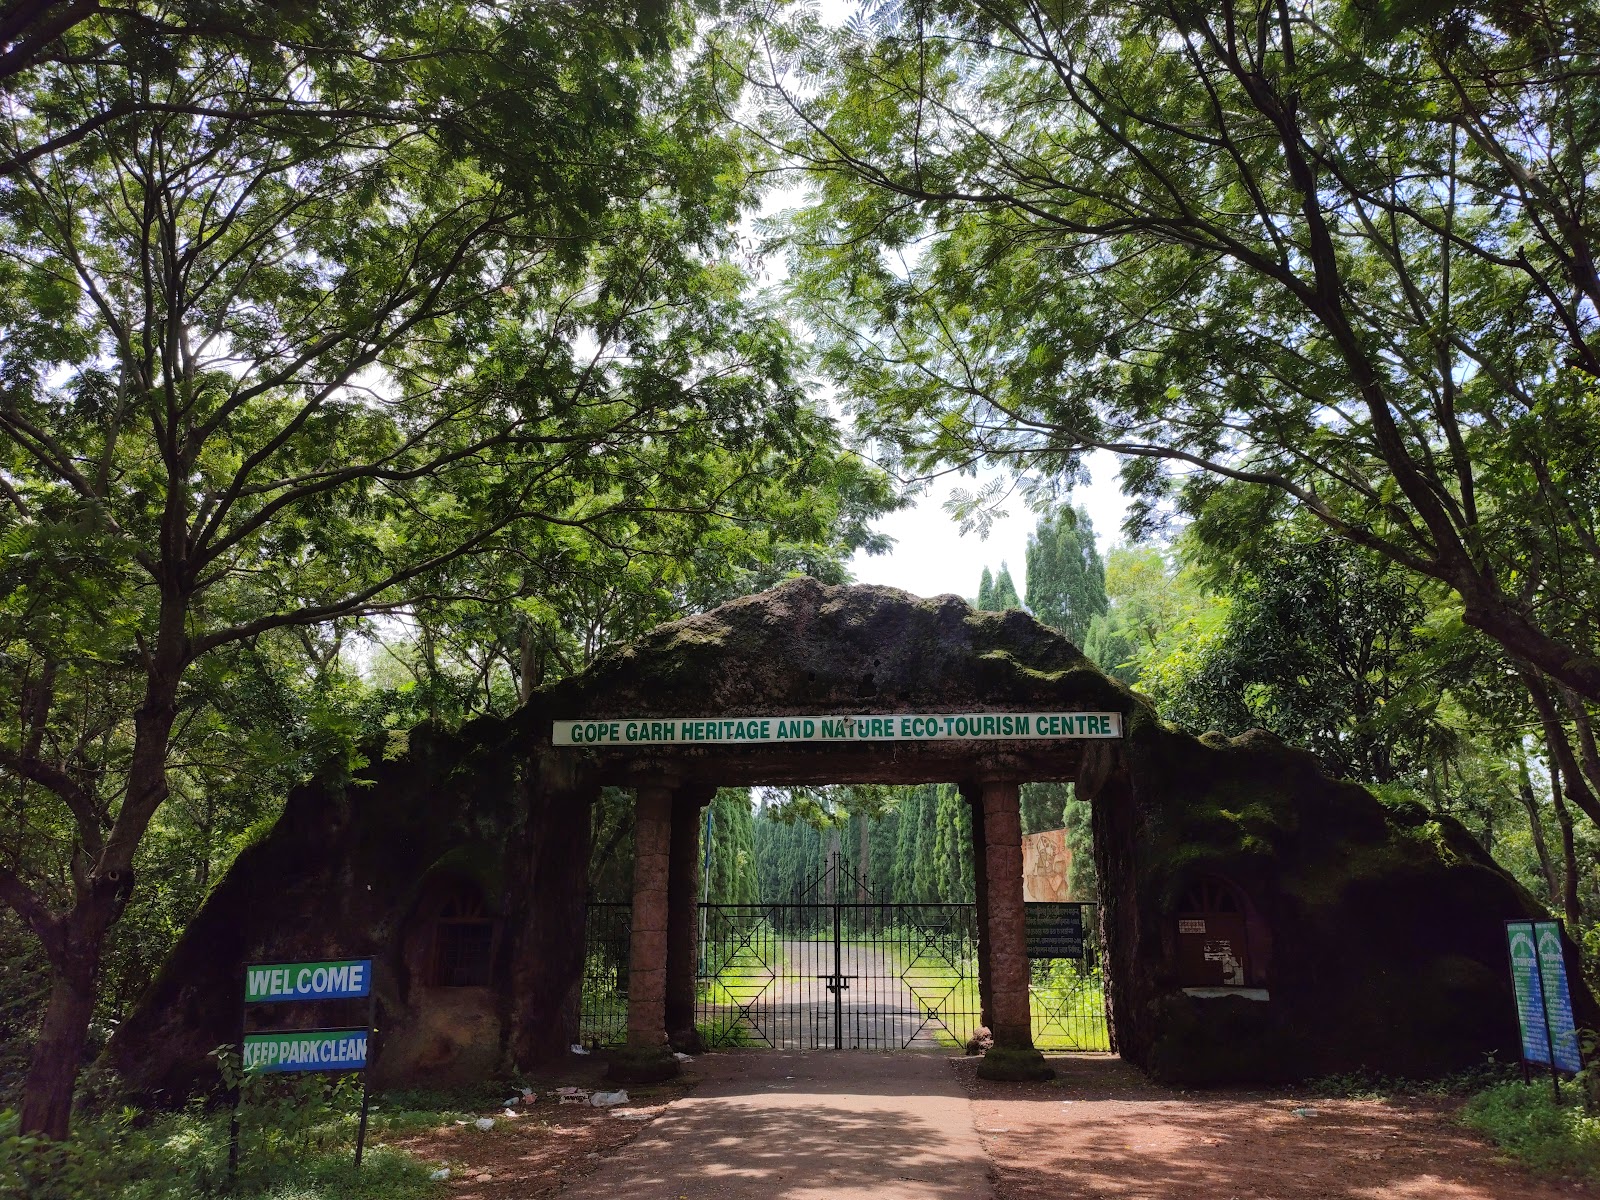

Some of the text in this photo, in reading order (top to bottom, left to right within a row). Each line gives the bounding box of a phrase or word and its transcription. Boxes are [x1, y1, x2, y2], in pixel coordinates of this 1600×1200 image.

[571, 715, 1112, 742] GOPE GARH HERITAGE AND NATURE ECO-TOURISM CENTRE
[249, 965, 364, 996] WELCOME
[243, 1038, 367, 1066] KEEP PARK CLEAN
